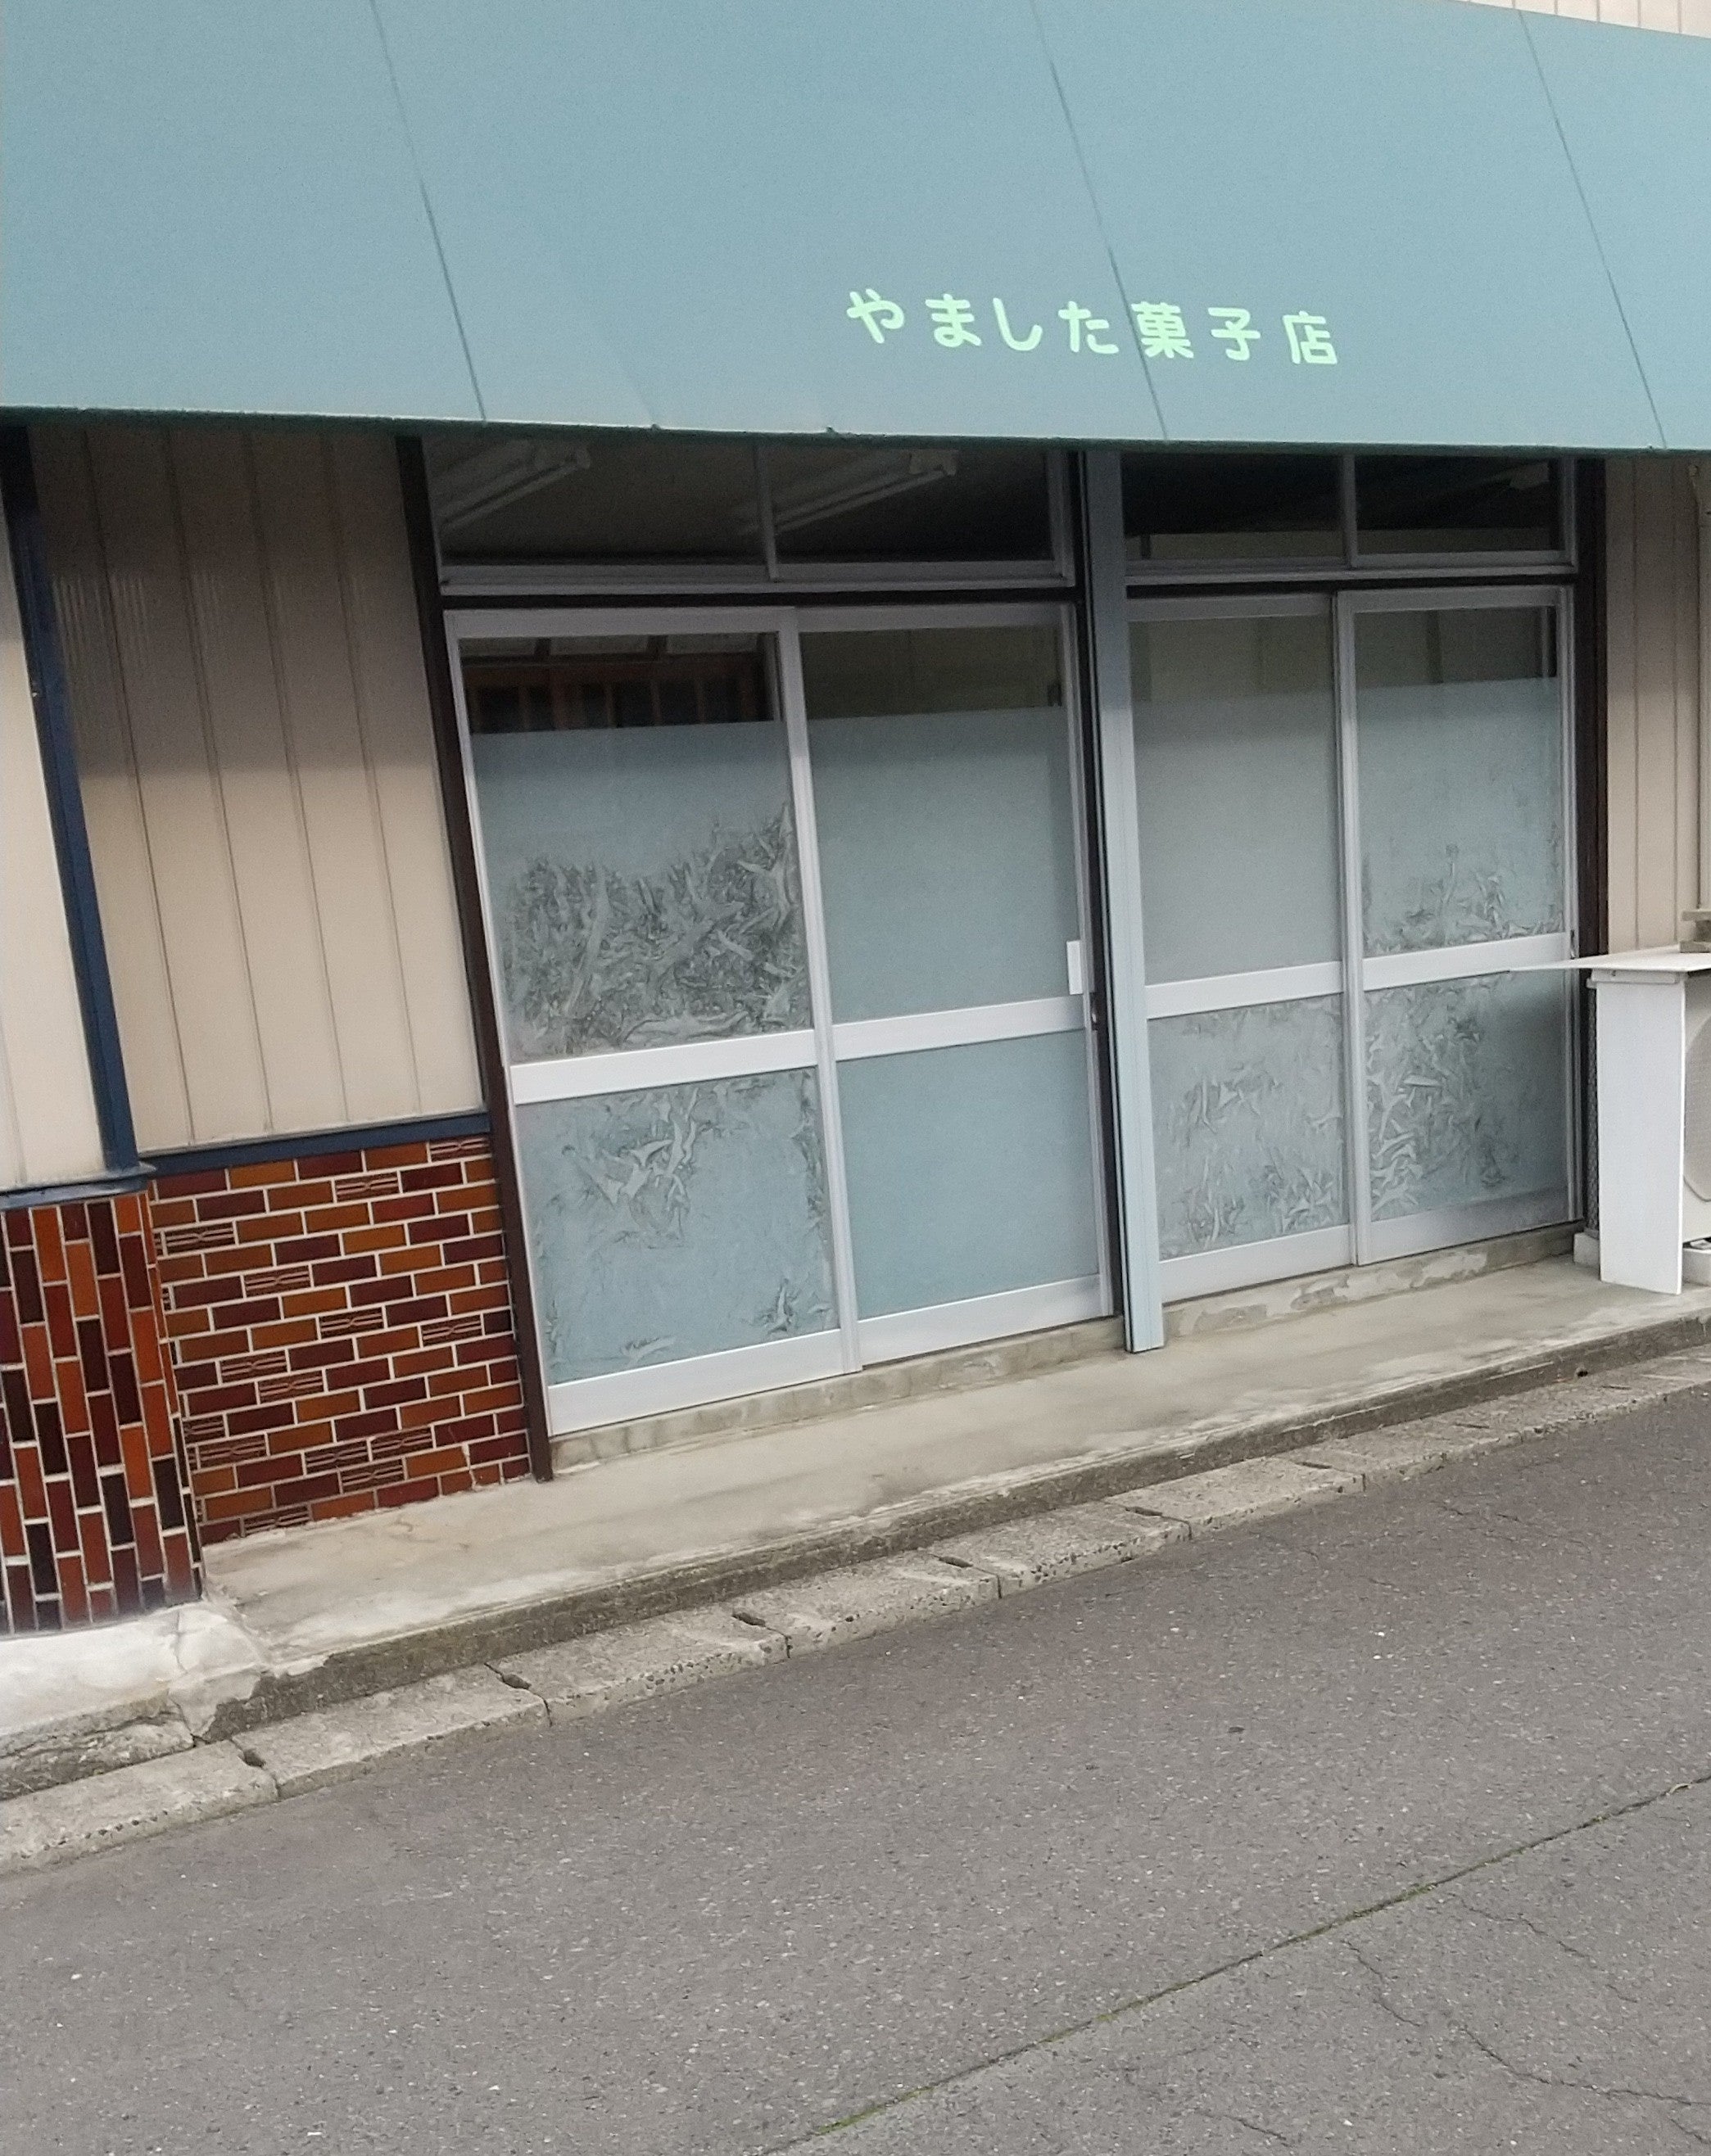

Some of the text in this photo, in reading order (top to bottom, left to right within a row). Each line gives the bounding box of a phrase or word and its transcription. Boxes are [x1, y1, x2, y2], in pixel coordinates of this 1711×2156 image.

[846, 288, 1338, 364] やました菓子店
